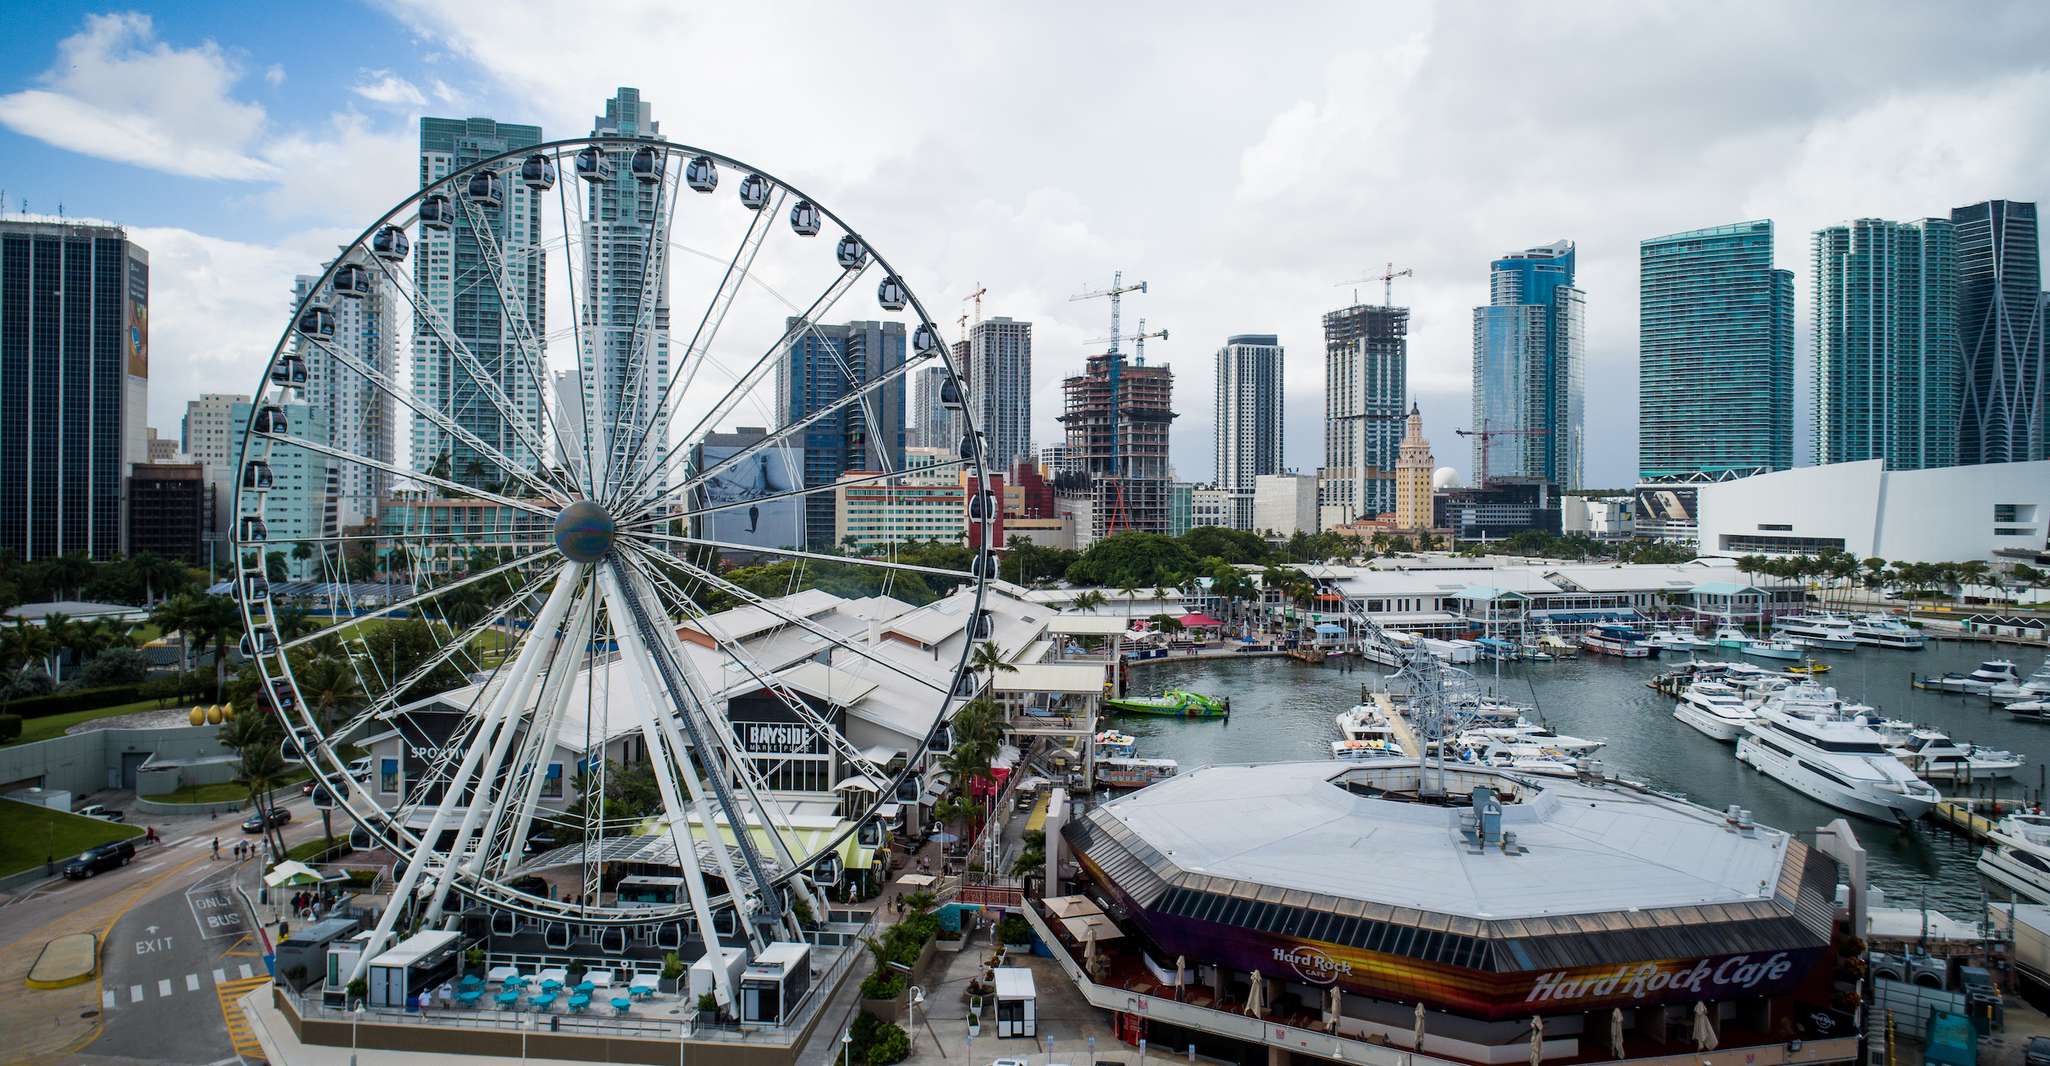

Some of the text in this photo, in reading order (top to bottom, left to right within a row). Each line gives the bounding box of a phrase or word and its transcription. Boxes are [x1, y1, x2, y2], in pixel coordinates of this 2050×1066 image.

[750, 726, 810, 745] BAYSIDE
[195, 896, 232, 910] ONLY
[207, 912, 241, 928] BUS
[135, 936, 173, 955] EXIT
[1271, 947, 1353, 977] Hard Rock
[1524, 952, 1792, 1003] Hard Rock Cafe
